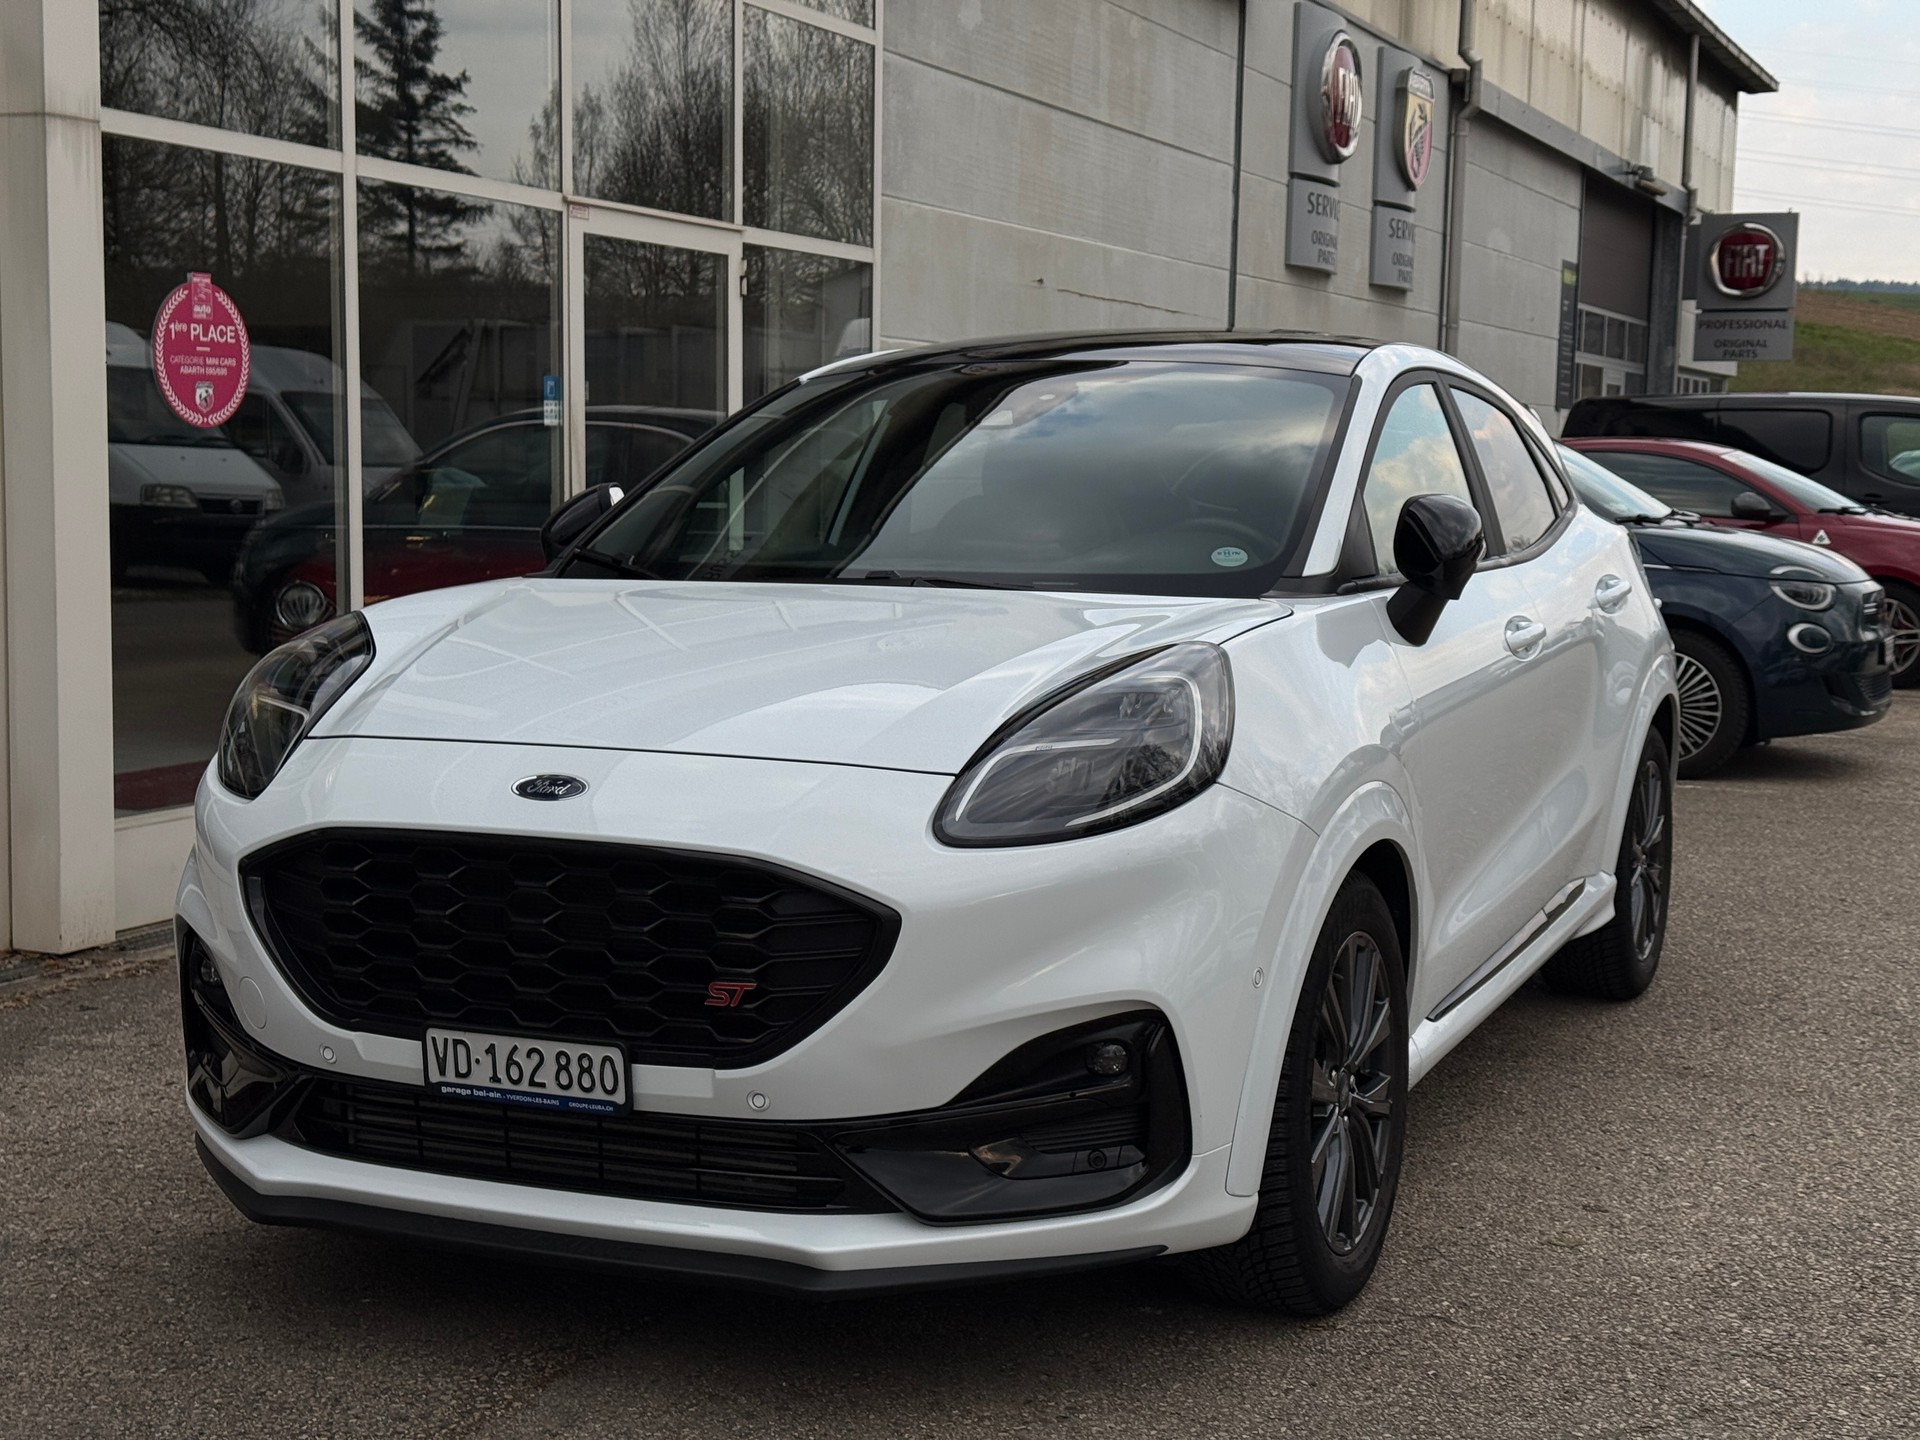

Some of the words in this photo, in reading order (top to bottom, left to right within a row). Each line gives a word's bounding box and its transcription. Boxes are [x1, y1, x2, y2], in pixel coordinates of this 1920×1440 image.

[1724, 244, 1770, 278] FIAT
[1699, 319, 1788, 330] PROFESSIONAL
[190, 323, 236, 344] PLACE
[1713, 338, 1768, 349] ORIGINAL
[1722, 349, 1758, 359] PARTS
[526, 779, 572, 795] Ford
[704, 981, 757, 1007] ST
[441, 1086, 471, 1096] garage
